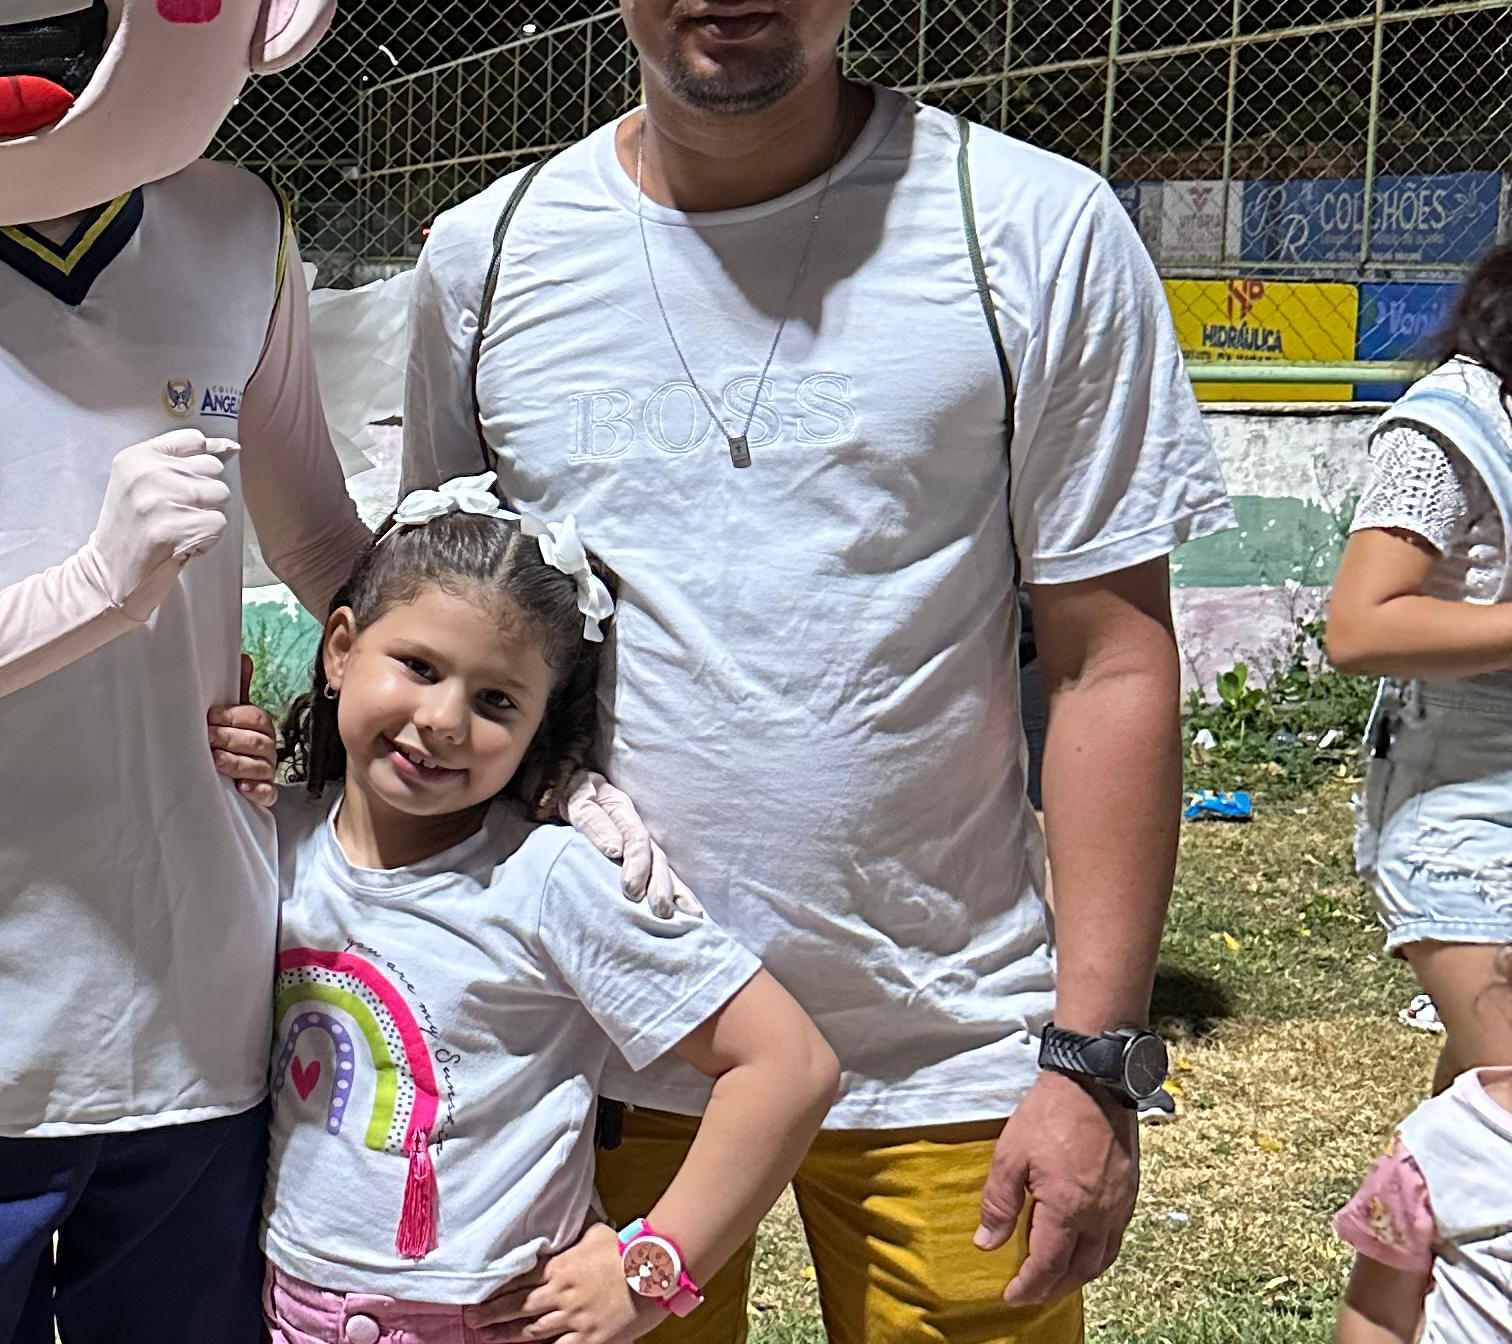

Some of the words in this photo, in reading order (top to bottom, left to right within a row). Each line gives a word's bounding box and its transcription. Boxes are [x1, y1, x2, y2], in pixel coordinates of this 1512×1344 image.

[1319, 182, 1448, 232] COLCHÕES
[568, 373, 857, 463] BOSS
[386, 961, 418, 996] are
